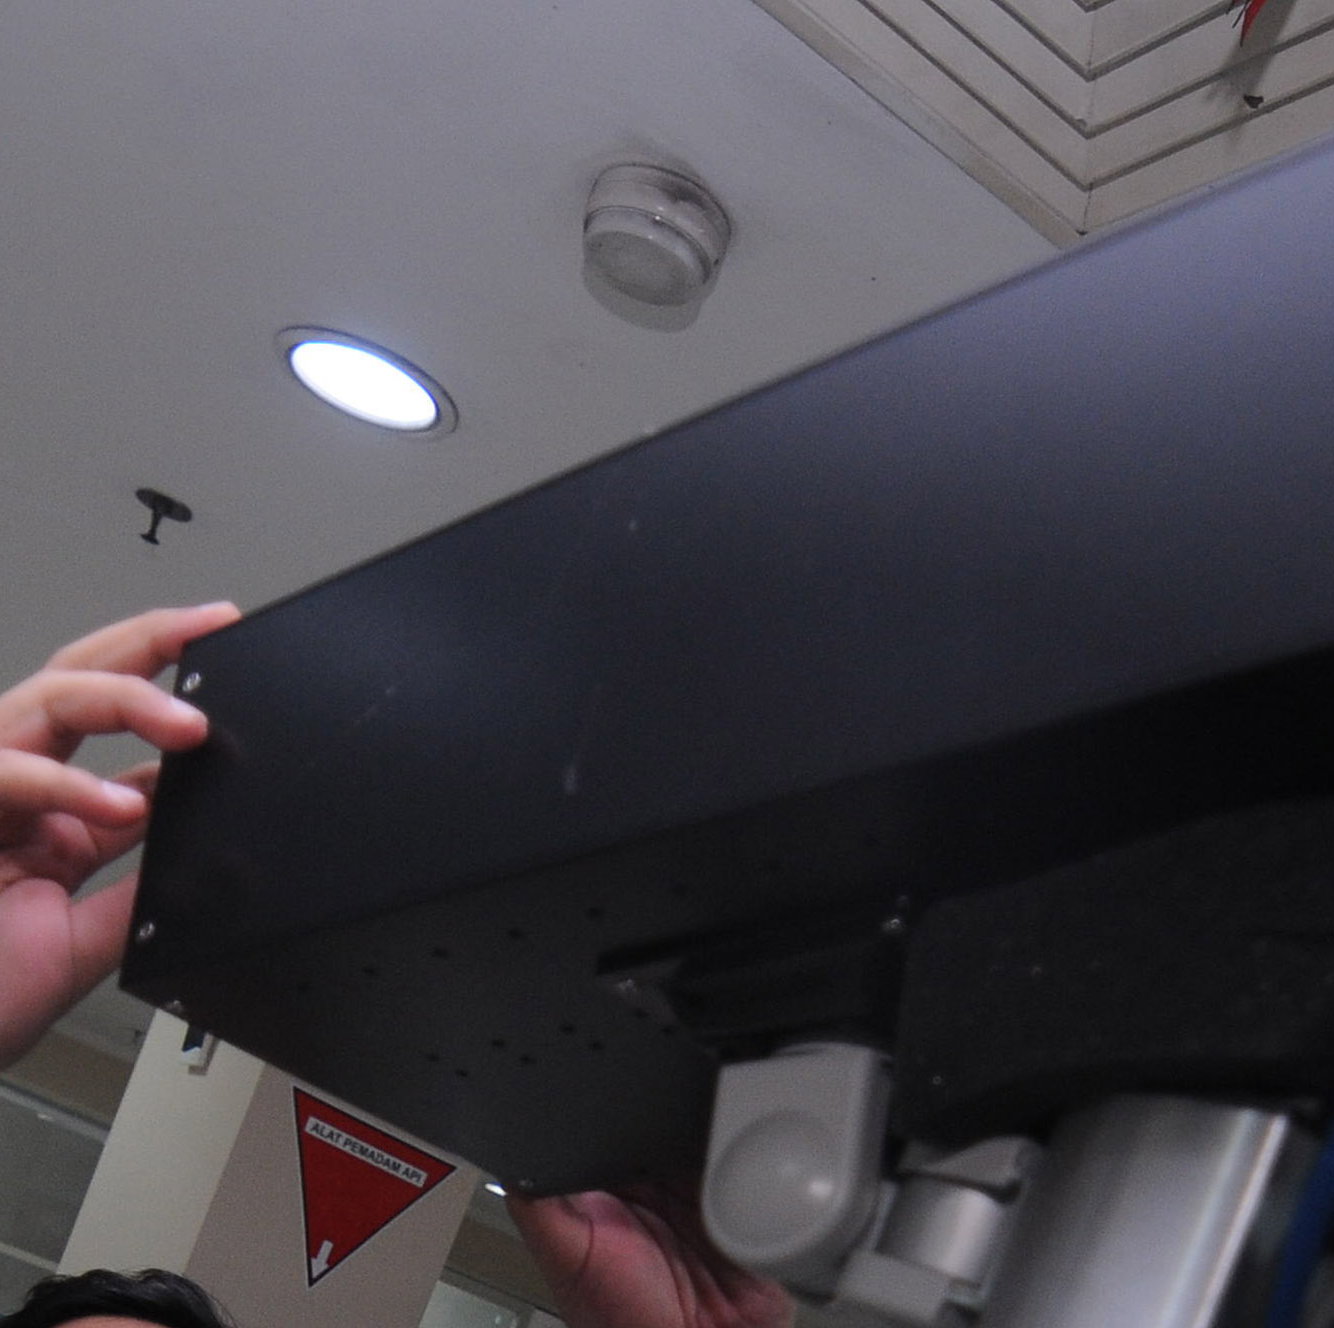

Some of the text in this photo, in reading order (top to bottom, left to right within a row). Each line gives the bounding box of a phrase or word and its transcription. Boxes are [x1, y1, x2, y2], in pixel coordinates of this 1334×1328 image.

[310, 1122, 422, 1183] ALAT PEMADAM API
